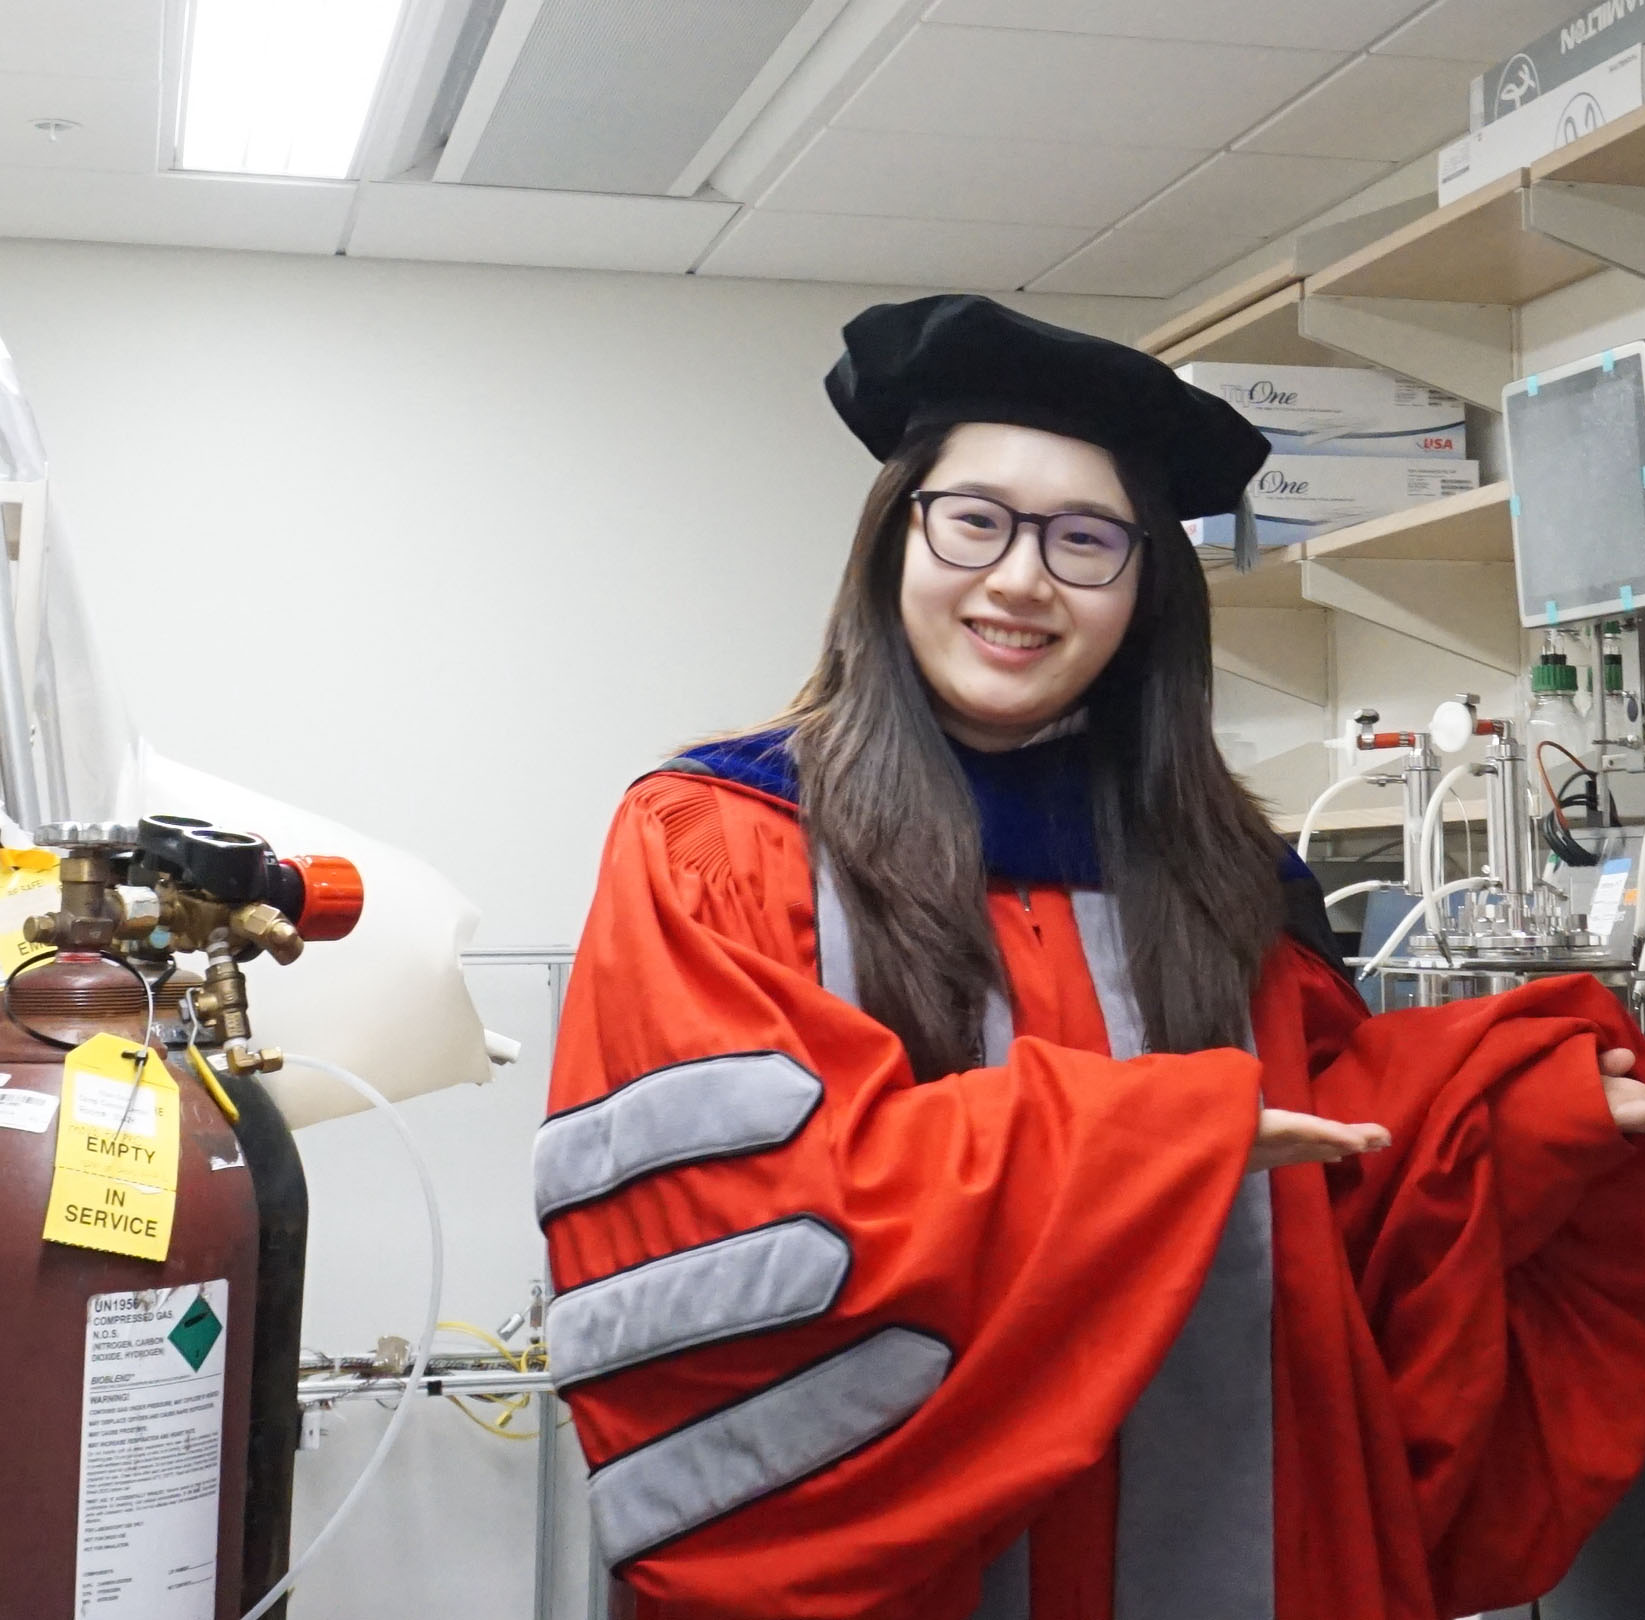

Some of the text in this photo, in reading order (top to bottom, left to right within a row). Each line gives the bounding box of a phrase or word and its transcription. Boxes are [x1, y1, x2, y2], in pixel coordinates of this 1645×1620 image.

[1423, 437, 1454, 450] USA
[86, 1136, 156, 1164] EMPTY
[104, 1188, 126, 1207] IN
[64, 1204, 159, 1238] SERVICE
[93, 1312, 154, 1327] COMPRESSED
